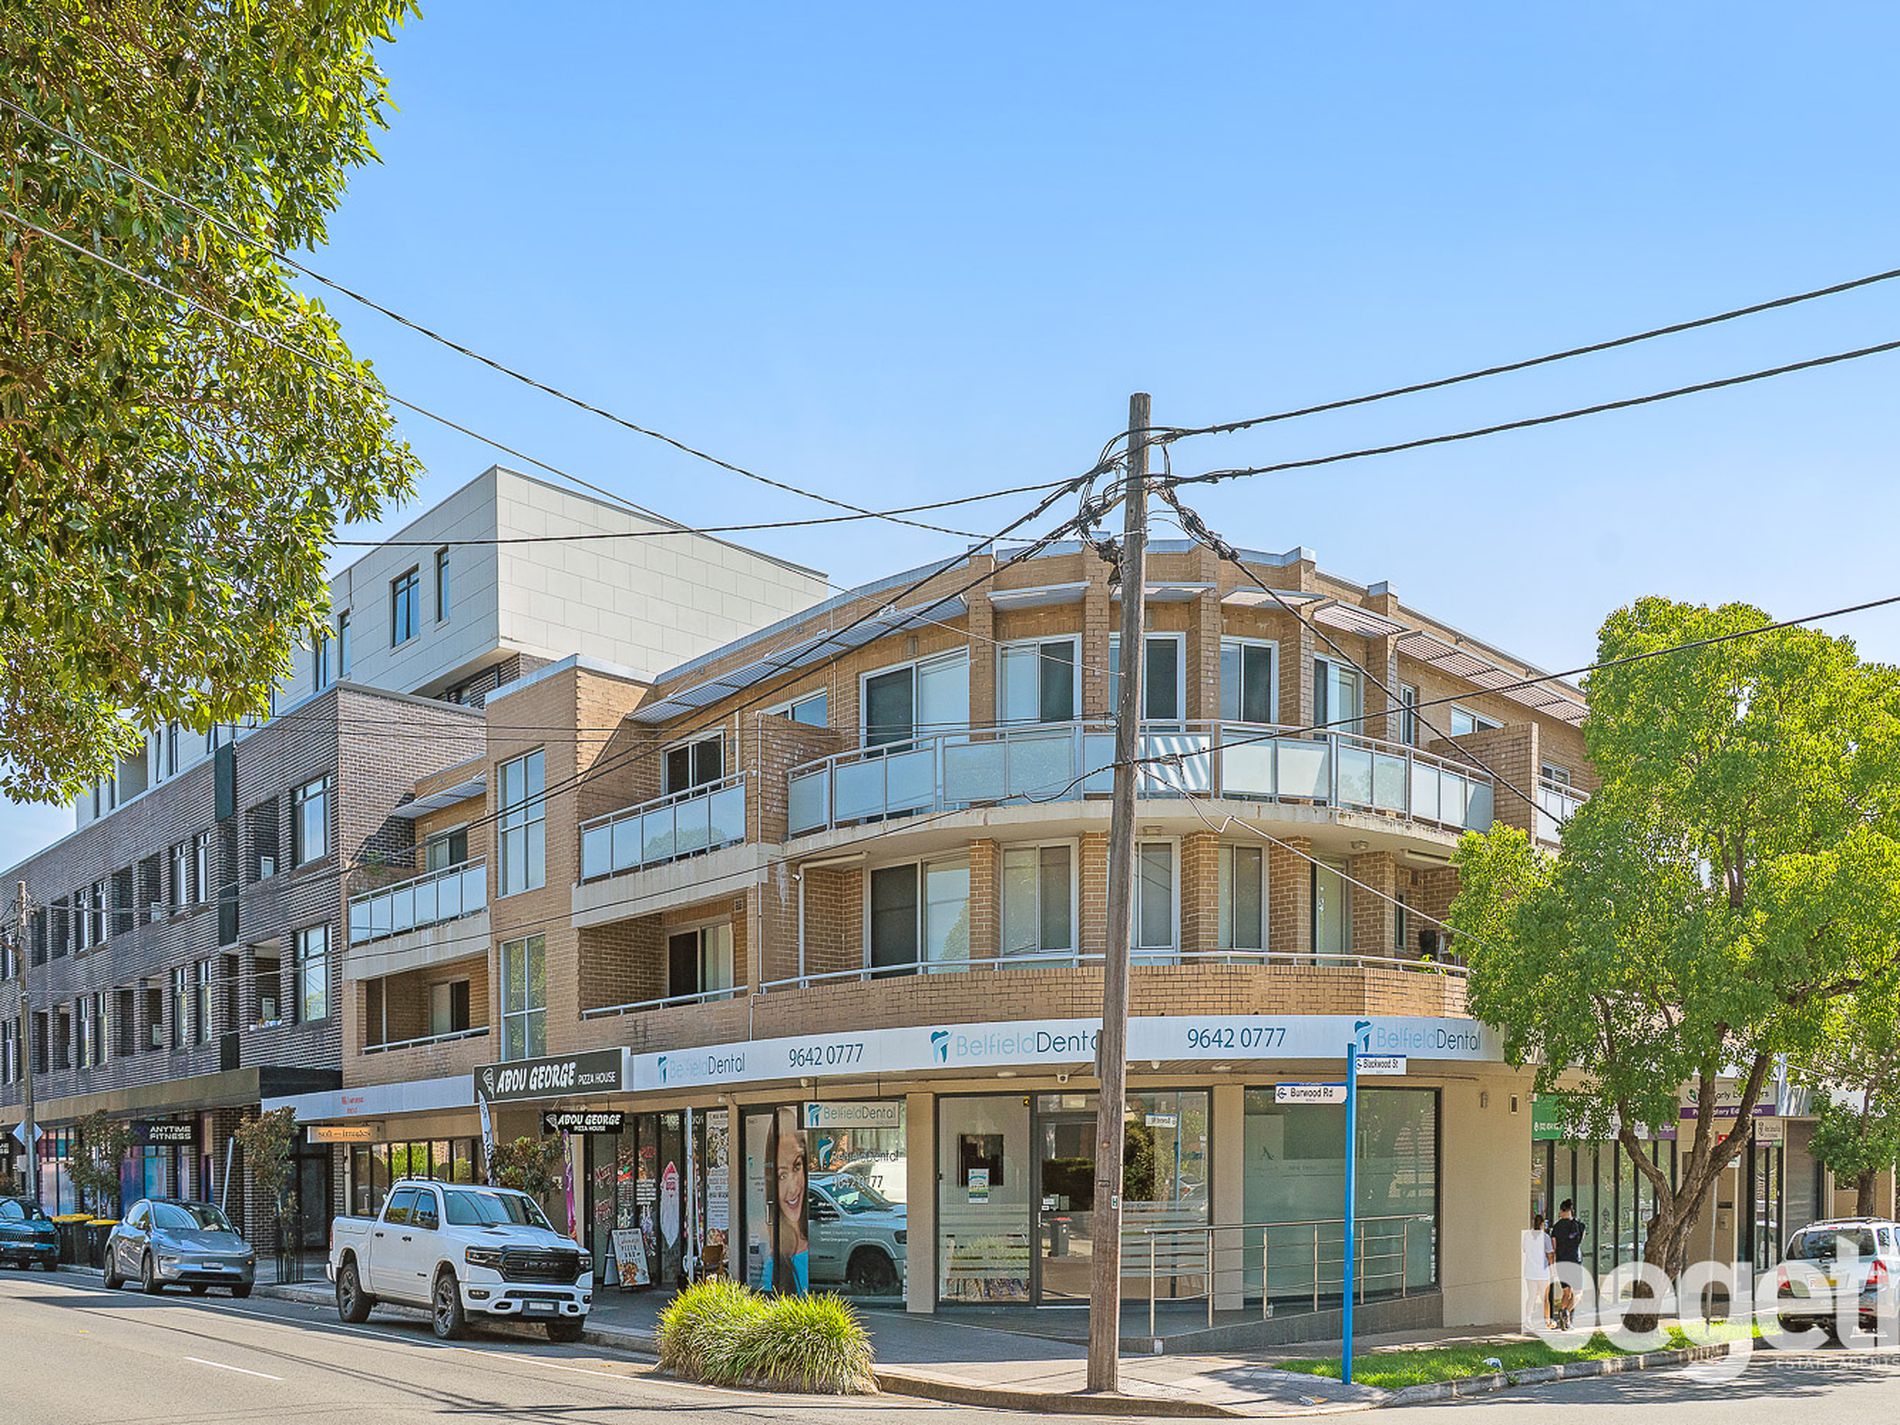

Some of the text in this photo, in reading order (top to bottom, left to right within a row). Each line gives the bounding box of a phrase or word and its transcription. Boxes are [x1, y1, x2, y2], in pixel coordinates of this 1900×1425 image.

[1187, 1027, 1287, 1049] 9642 0777
[789, 1043, 864, 1067] 9642 0777
[1363, 1059, 1399, 1069] Blackwood St
[496, 1061, 616, 1094] ABOU GEORGE PIZZA HOUSE
[1290, 1087, 1333, 1097] Burwood Rd
[557, 1113, 621, 1125] ABOU GEORGE
[150, 1125, 192, 1133] ANYTIME
[150, 1132, 192, 1140] FITNESS
